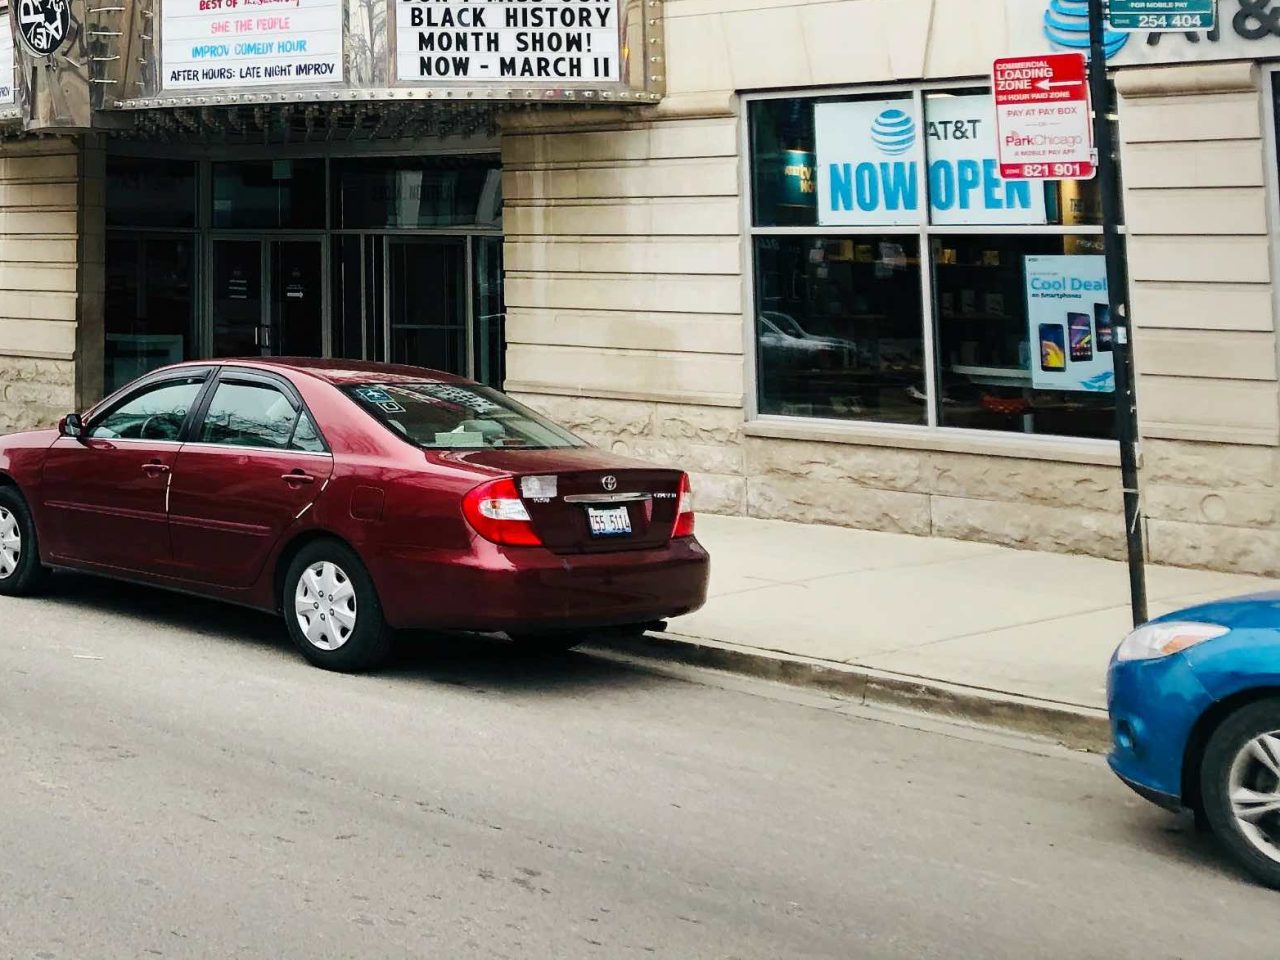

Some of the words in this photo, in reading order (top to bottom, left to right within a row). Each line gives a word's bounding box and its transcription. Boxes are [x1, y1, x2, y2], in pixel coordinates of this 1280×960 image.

[199, 0, 222, 11] BEST
[410, 7, 486, 27] BLACK
[505, 7, 611, 27] HISTORY
[1139, 15, 1167, 27] 254
[1172, 15, 1201, 27] 404
[211, 21, 230, 34] SHE
[234, 19, 253, 33] THE
[257, 17, 290, 31] PEOPLE
[192, 45, 229, 59] IMPROV
[234, 42, 273, 56] COMEDY
[278, 40, 307, 53] HOUR
[418, 31, 499, 52] MONTH
[516, 32, 592, 53] SHOW!
[170, 70, 199, 82] AFTER
[202, 67, 236, 80] HOURS:
[239, 66, 261, 79] LATE
[264, 64, 293, 77] NIGHT
[296, 62, 335, 76] IMPROV
[420, 56, 470, 76] NOW
[499, 57, 582, 77] MARCH
[996, 61, 1049, 70] COMMERCIAL
[997, 68, 1053, 80] LOADING
[997, 80, 1032, 91] ZONE
[1057, 107, 1077, 115] BOX
[927, 119, 982, 141] AT&T
[1006, 133, 1083, 147] ParkChicago
[1023, 165, 1049, 177] 821
[1054, 164, 1080, 176] 901
[829, 161, 918, 212] NOW
[930, 159, 1032, 210] OPEN
[1031, 276, 1065, 291] Cool
